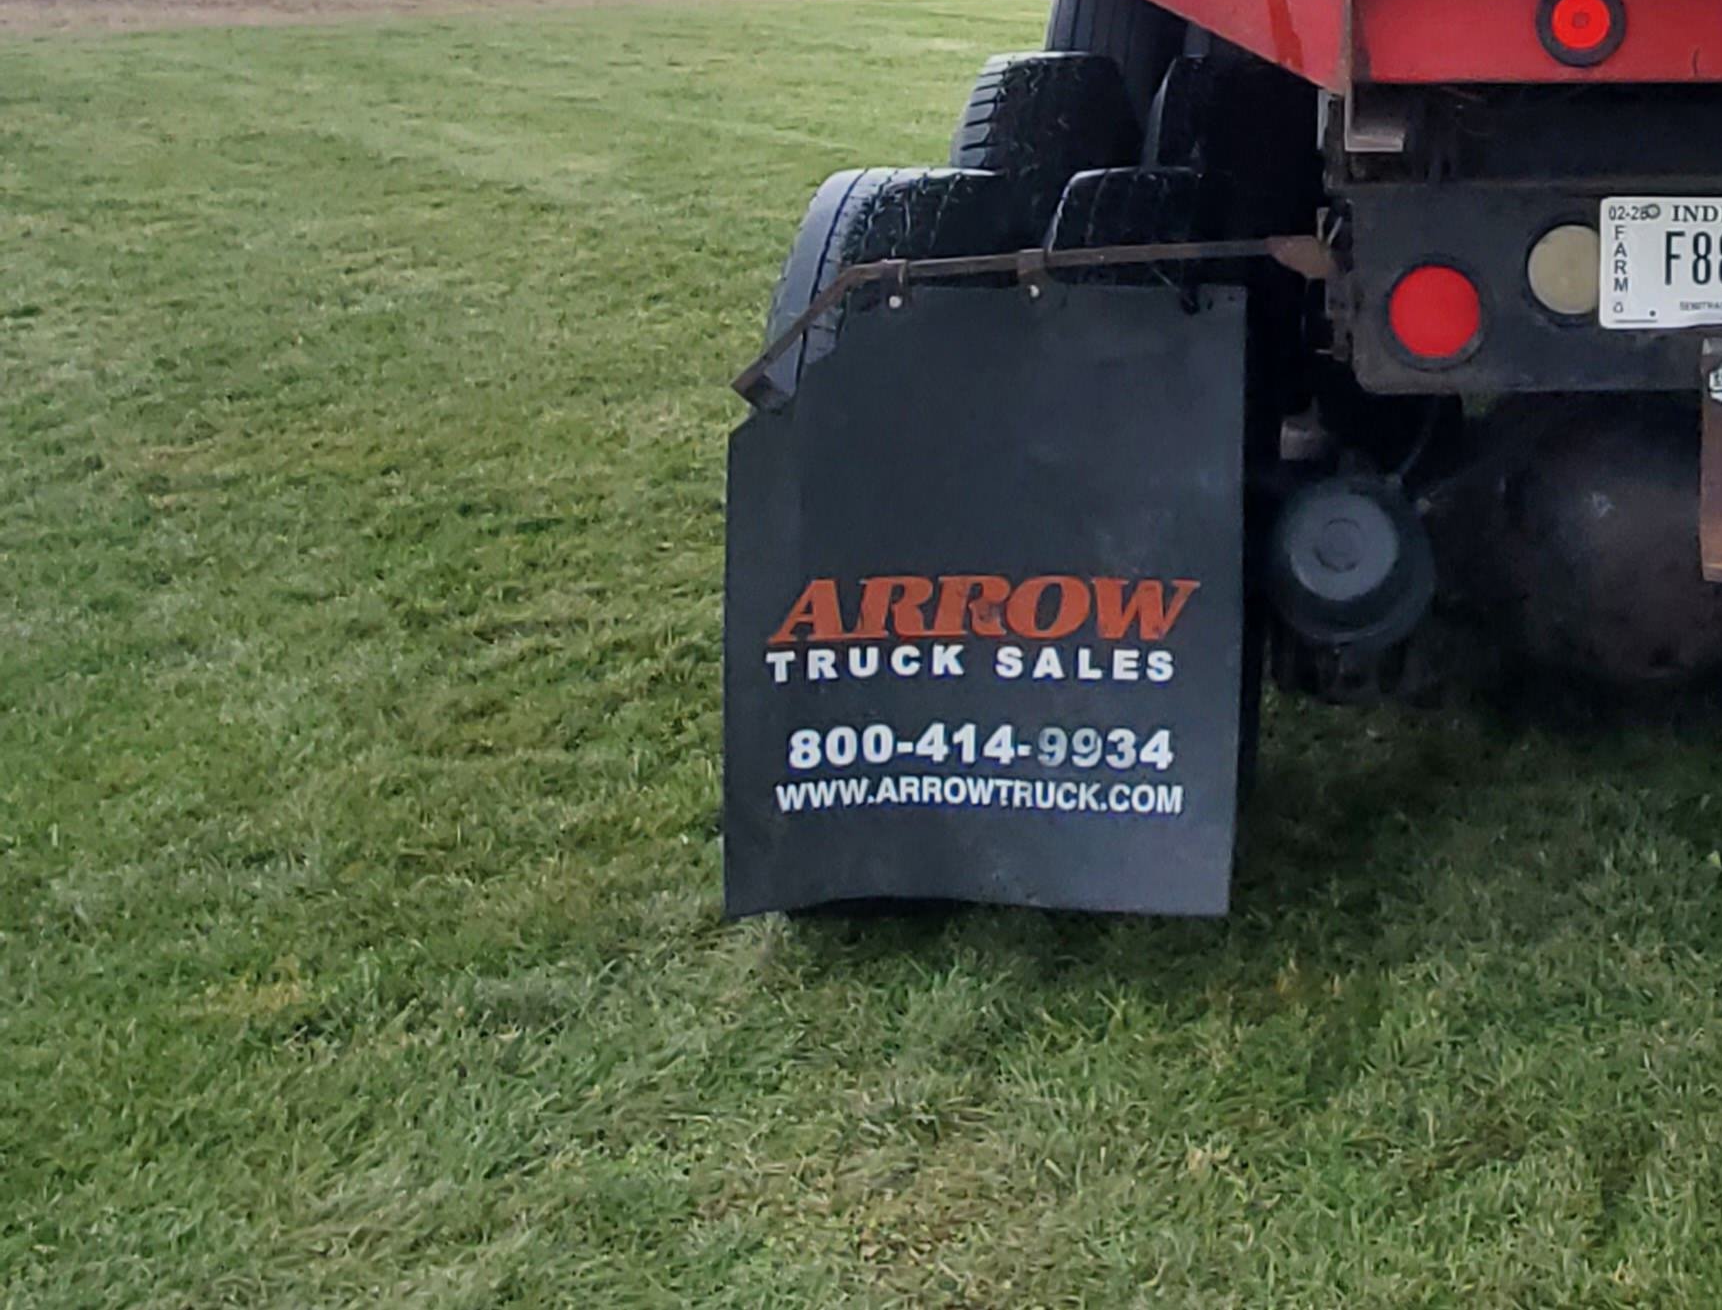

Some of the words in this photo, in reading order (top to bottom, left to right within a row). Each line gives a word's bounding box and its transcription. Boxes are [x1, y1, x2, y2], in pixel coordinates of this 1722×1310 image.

[1613, 225, 1629, 293] FARM
[767, 574, 1200, 645] ARROW
[766, 644, 965, 683] TRUCK
[995, 645, 1176, 682] SALES
[788, 722, 1174, 770] 800-414-9934
[775, 775, 1184, 815] WWW.ARROWTRUCK.COM
